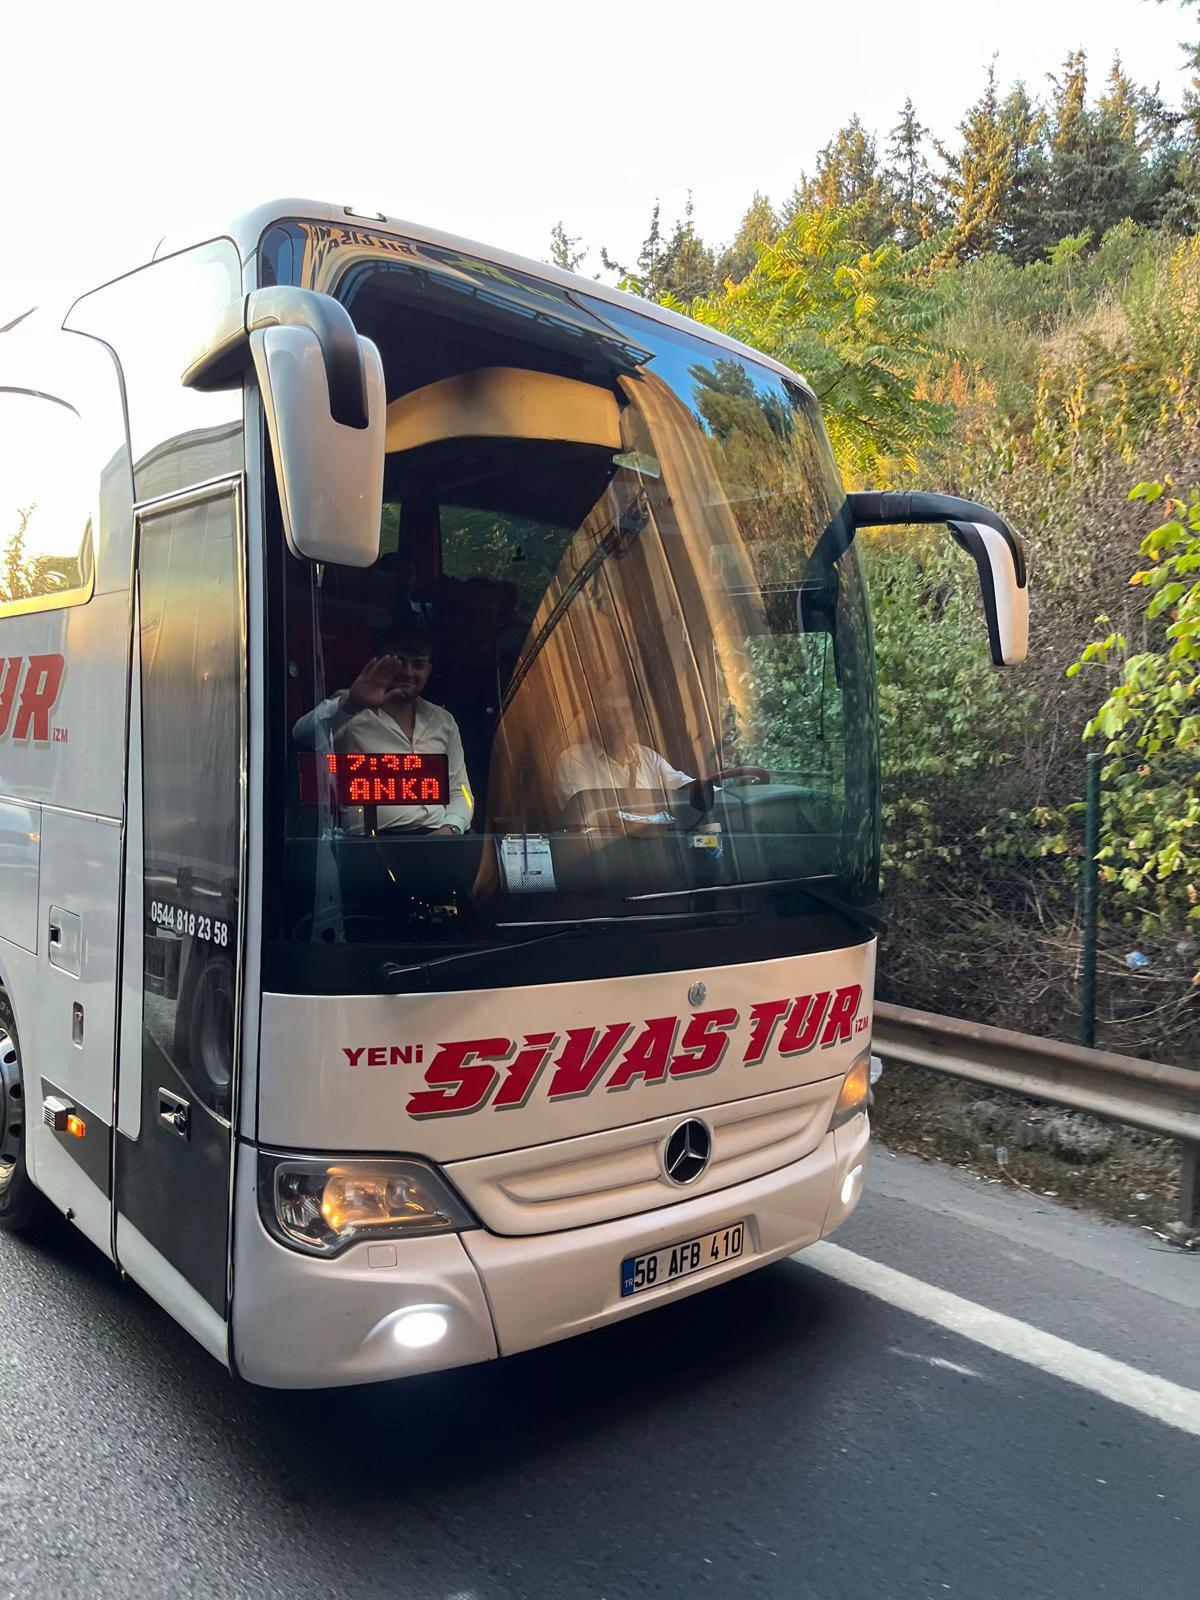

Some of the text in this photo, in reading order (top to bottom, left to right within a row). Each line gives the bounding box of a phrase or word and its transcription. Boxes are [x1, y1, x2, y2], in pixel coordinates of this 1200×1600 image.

[351, 778, 439, 800] ANKA
[151, 900, 228, 947] 0544 818 23 58
[743, 984, 862, 1067] TUR
[623, 1227, 741, 1288] TR 58 AFB 410
